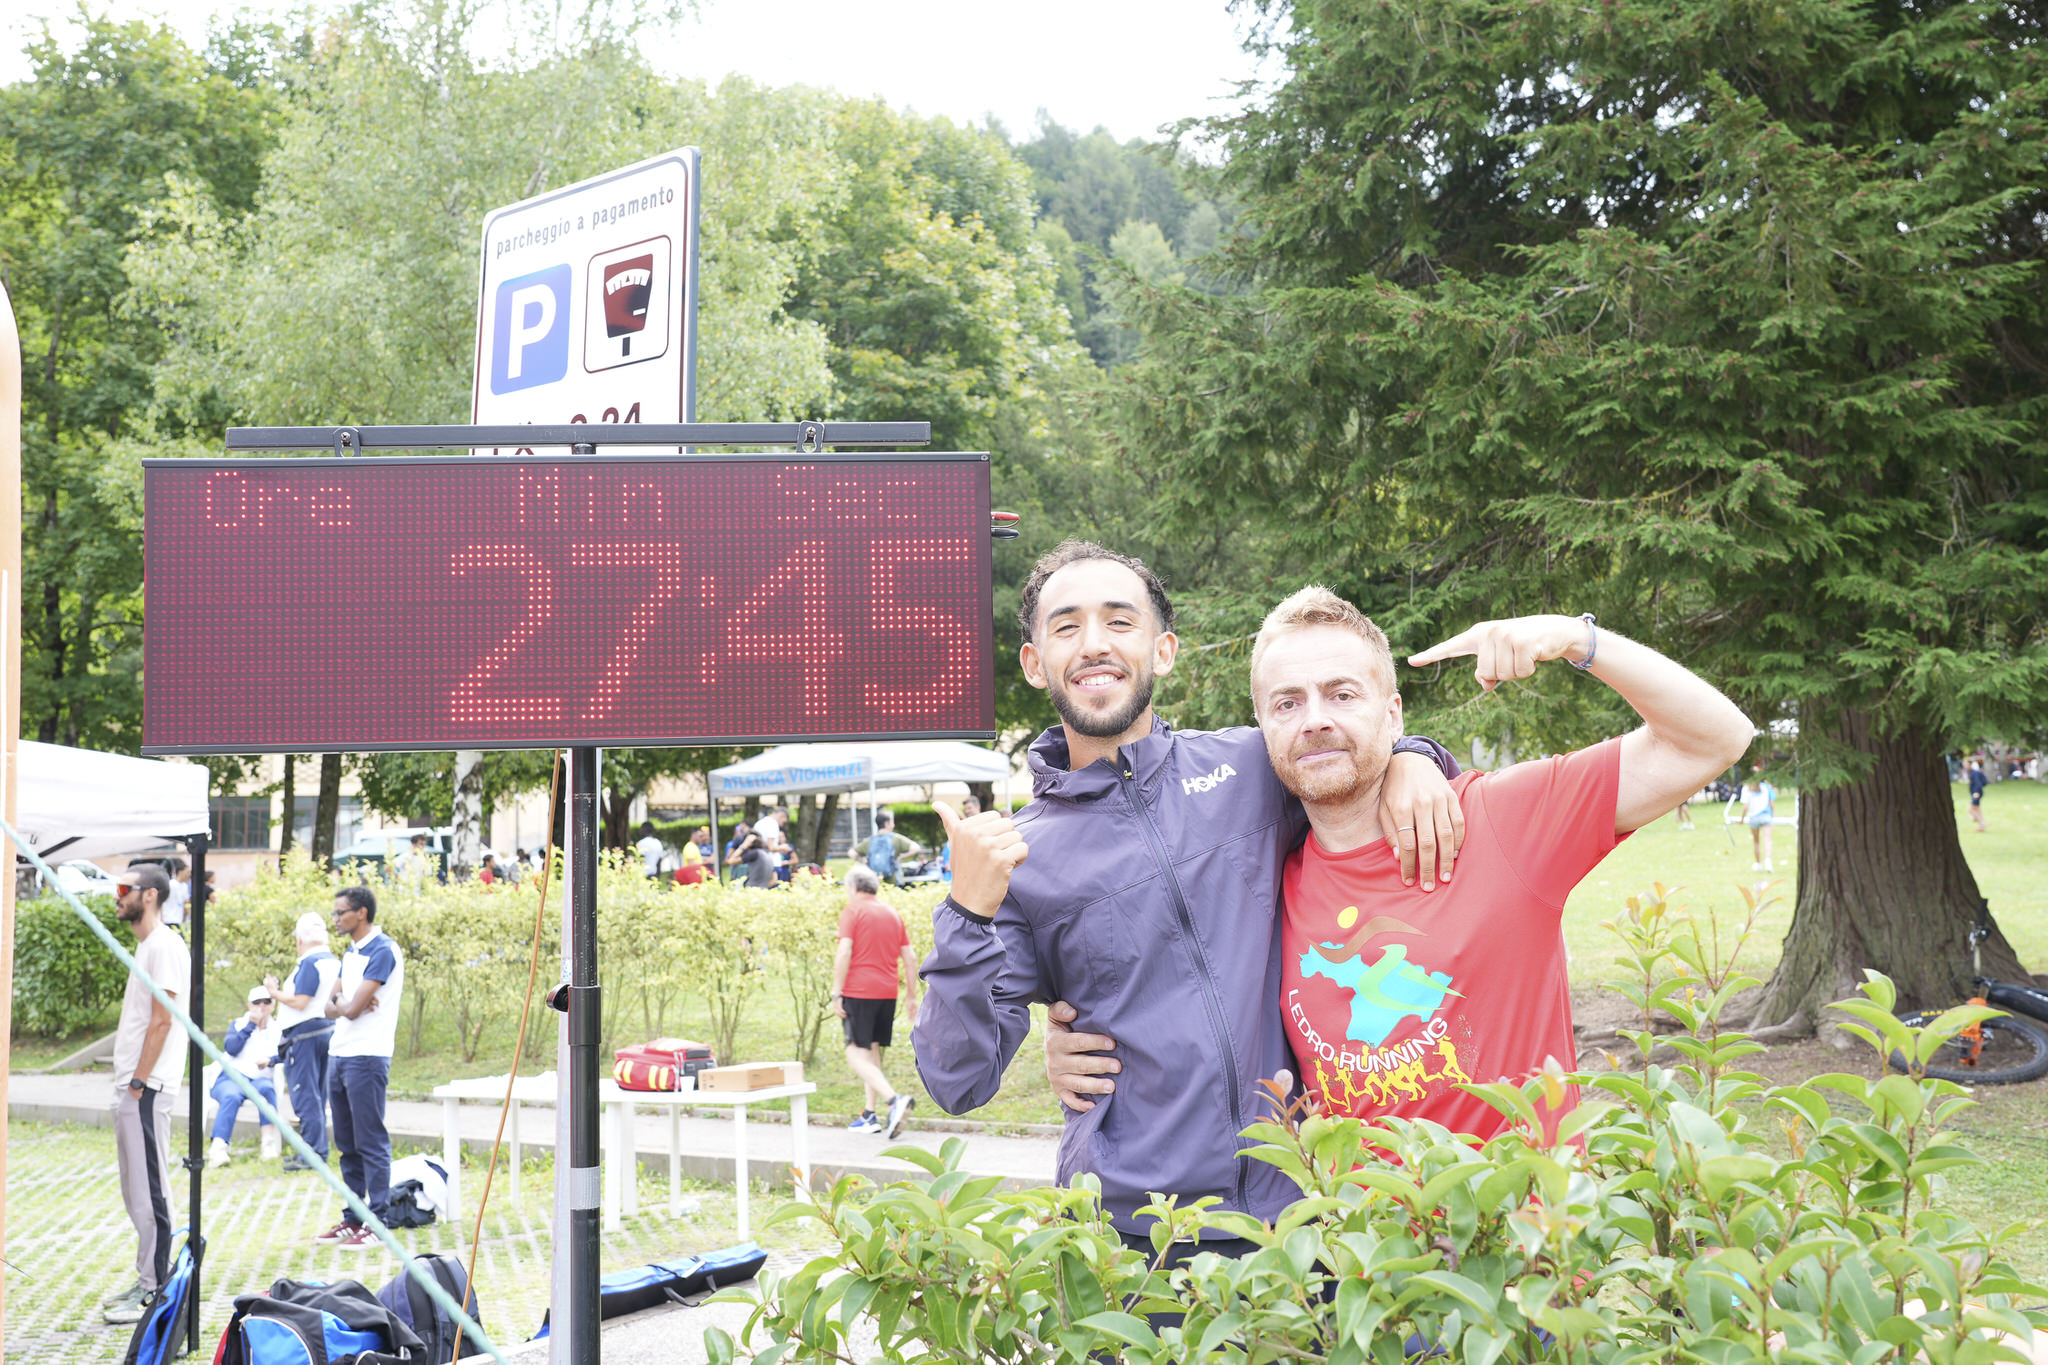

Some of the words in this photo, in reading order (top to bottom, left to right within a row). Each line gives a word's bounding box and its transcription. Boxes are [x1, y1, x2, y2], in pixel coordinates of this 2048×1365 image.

[497, 218, 570, 259] parcheggio
[577, 215, 585, 231] a
[592, 186, 674, 230] pagamento
[507, 283, 557, 379] P
[206, 471, 351, 527] Ore
[518, 467, 663, 523] Min
[775, 465, 918, 520] Sec
[450, 538, 971, 722] 27:45
[723, 771, 785, 790] ATLETICA
[788, 761, 862, 784] VIGHENZI
[1181, 763, 1237, 796] HOKA
[1288, 988, 1335, 1062] LEDRO
[1338, 1017, 1448, 1073] RUNNING
